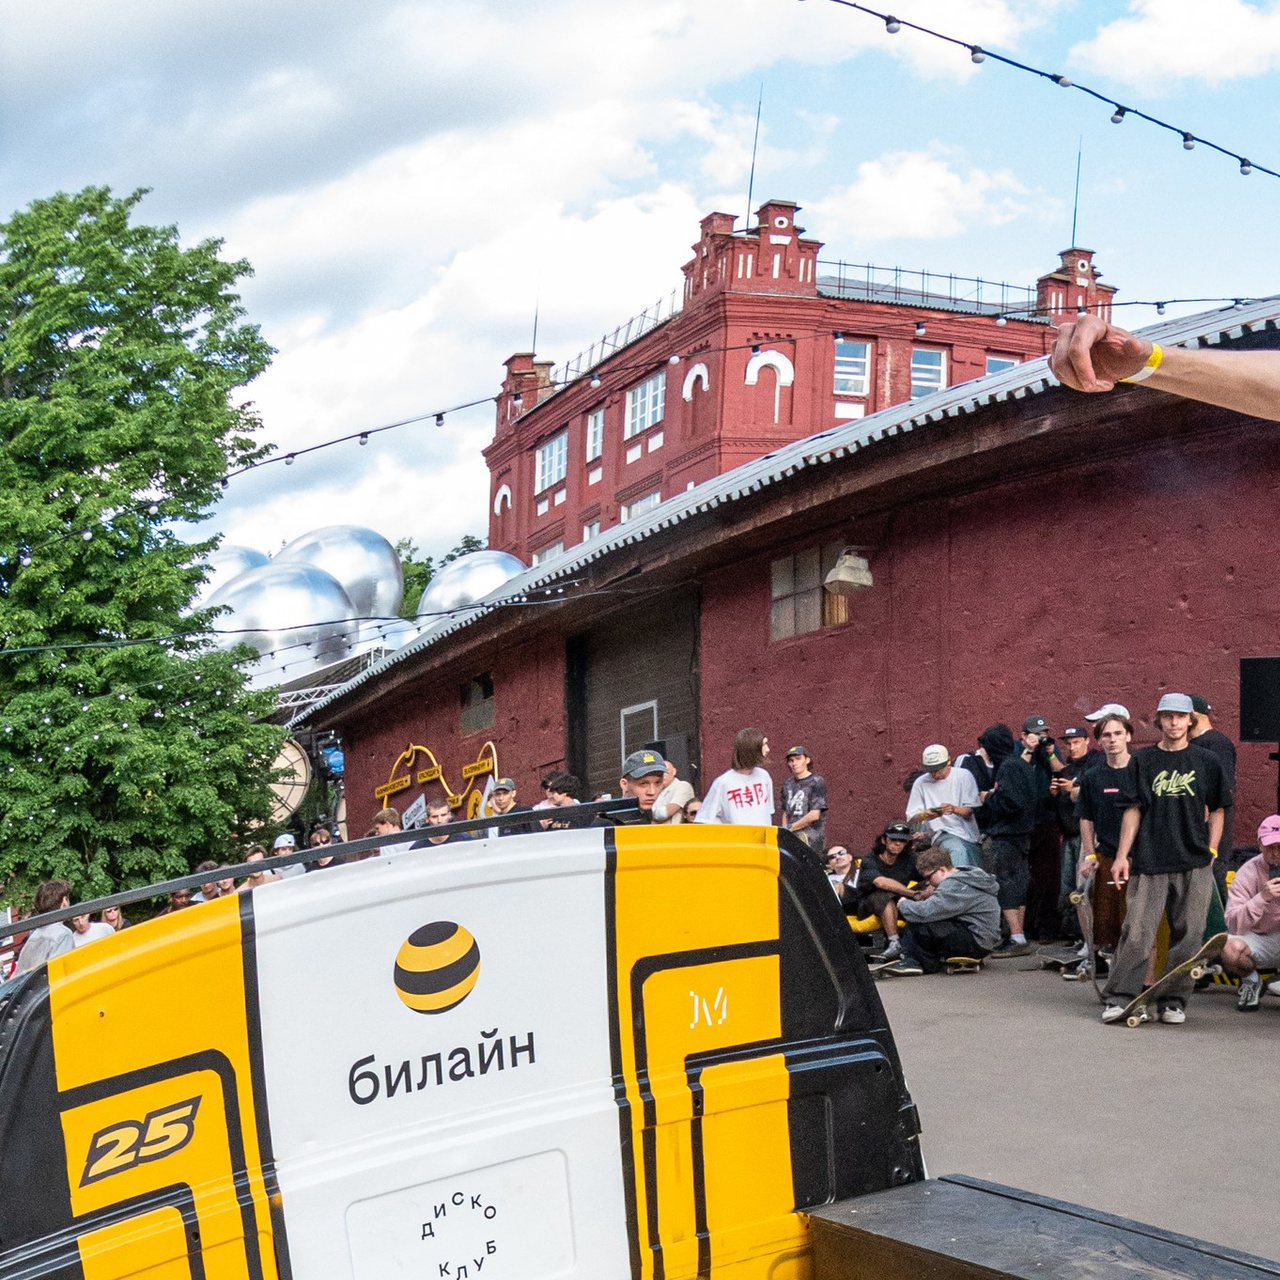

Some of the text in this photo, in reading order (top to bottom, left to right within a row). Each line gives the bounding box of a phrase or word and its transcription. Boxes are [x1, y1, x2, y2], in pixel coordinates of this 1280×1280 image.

[348, 1027, 536, 1106] билайн
[78, 1094, 203, 1188] 25
[421, 1191, 497, 1241] ДИСКО
